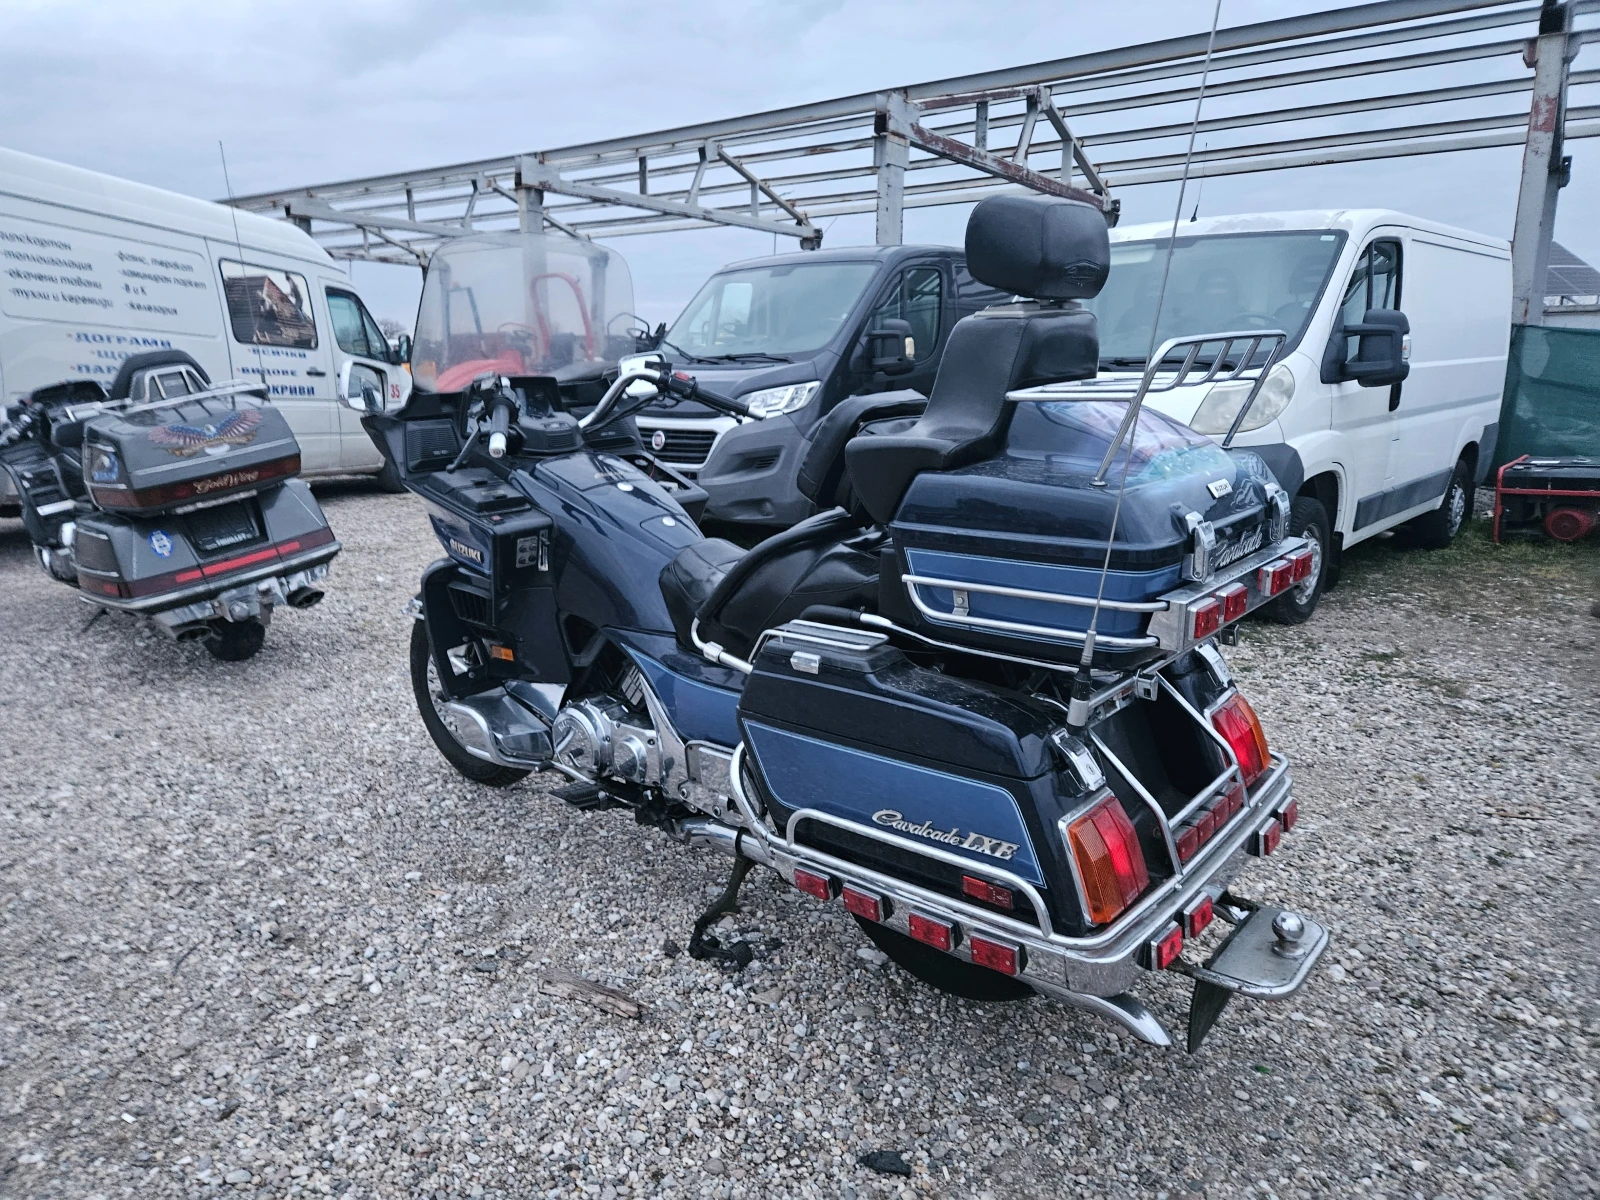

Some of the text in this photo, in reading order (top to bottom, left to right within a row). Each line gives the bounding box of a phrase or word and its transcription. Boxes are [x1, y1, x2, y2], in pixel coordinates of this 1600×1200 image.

[75, 332, 172, 349] ДОГРАМИ
[252, 347, 307, 359] ВСИЧКИ
[241, 366, 297, 377] ВИДОВЕ
[390, 384, 400, 399] 35
[450, 538, 483, 564] SUZUKI
[871, 808, 1021, 861] Cavalcade LXE
